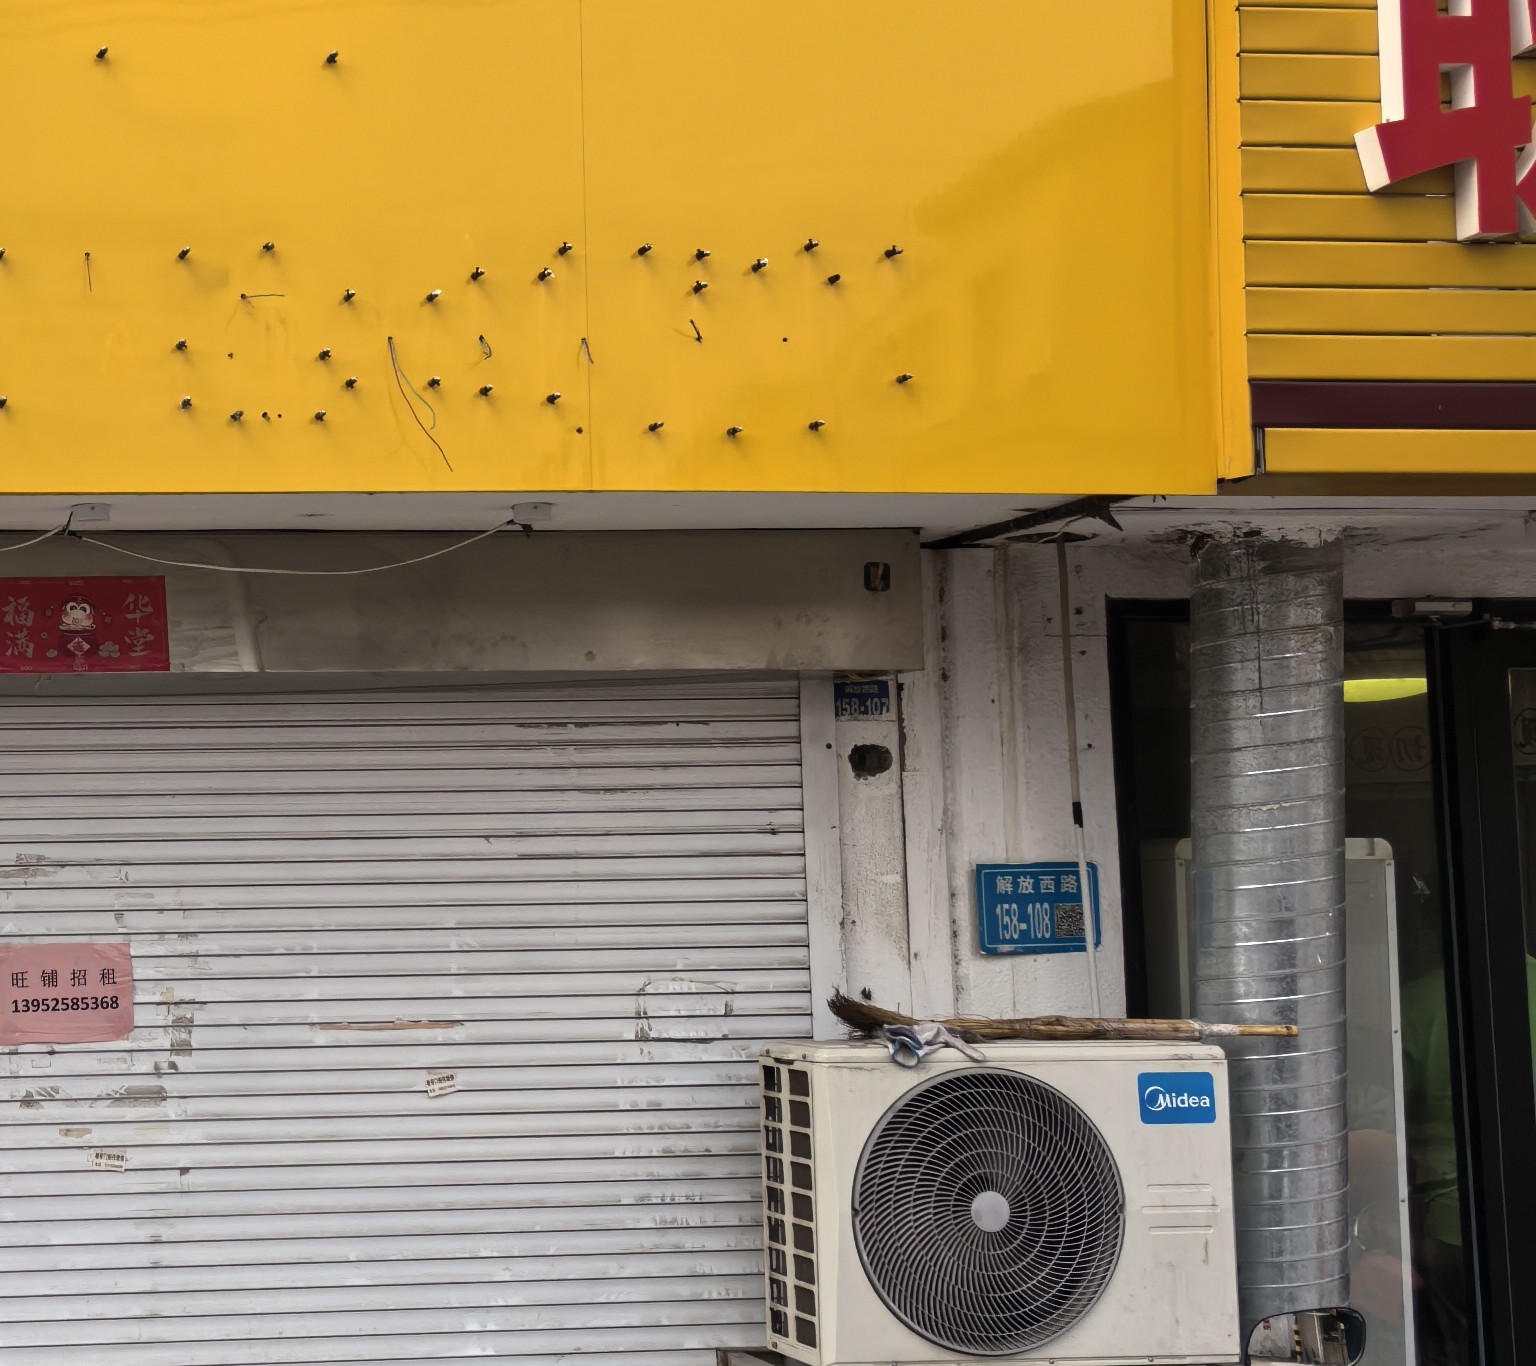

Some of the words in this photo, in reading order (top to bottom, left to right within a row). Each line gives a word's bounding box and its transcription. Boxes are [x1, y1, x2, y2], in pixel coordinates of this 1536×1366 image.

[996, 875, 1078, 894] 解放西路
[995, 902, 1051, 939] 158-108
[11, 968, 117, 988] 旺铺招租
[11, 995, 120, 1013] 13952585368
[1145, 1086, 1210, 1111] Midea
